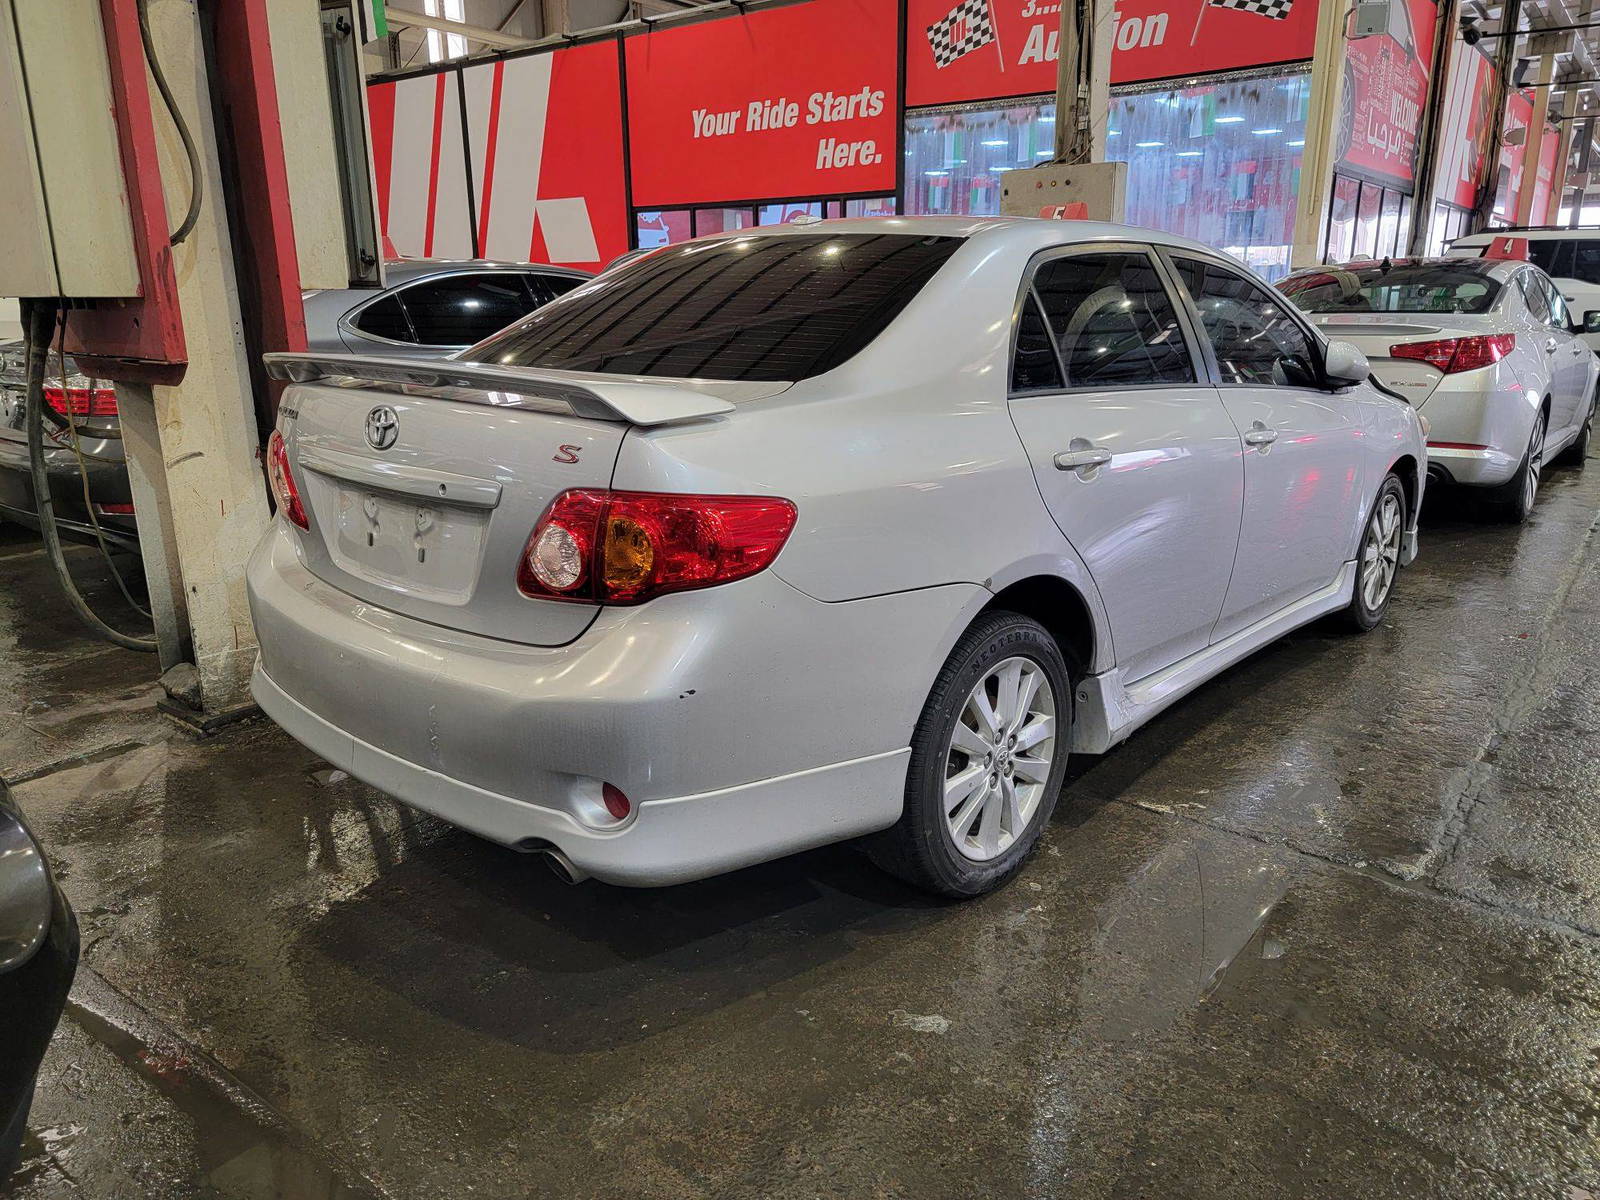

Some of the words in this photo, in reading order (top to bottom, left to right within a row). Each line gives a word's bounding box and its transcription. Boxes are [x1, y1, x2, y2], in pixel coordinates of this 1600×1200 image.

[1017, 12, 1169, 66] Auion
[692, 108, 742, 139] Your
[746, 97, 800, 132] Ride
[805, 86, 885, 125] Starts
[815, 137, 882, 170] Here.
[1503, 238, 1514, 254] 4
[551, 444, 583, 464] S
